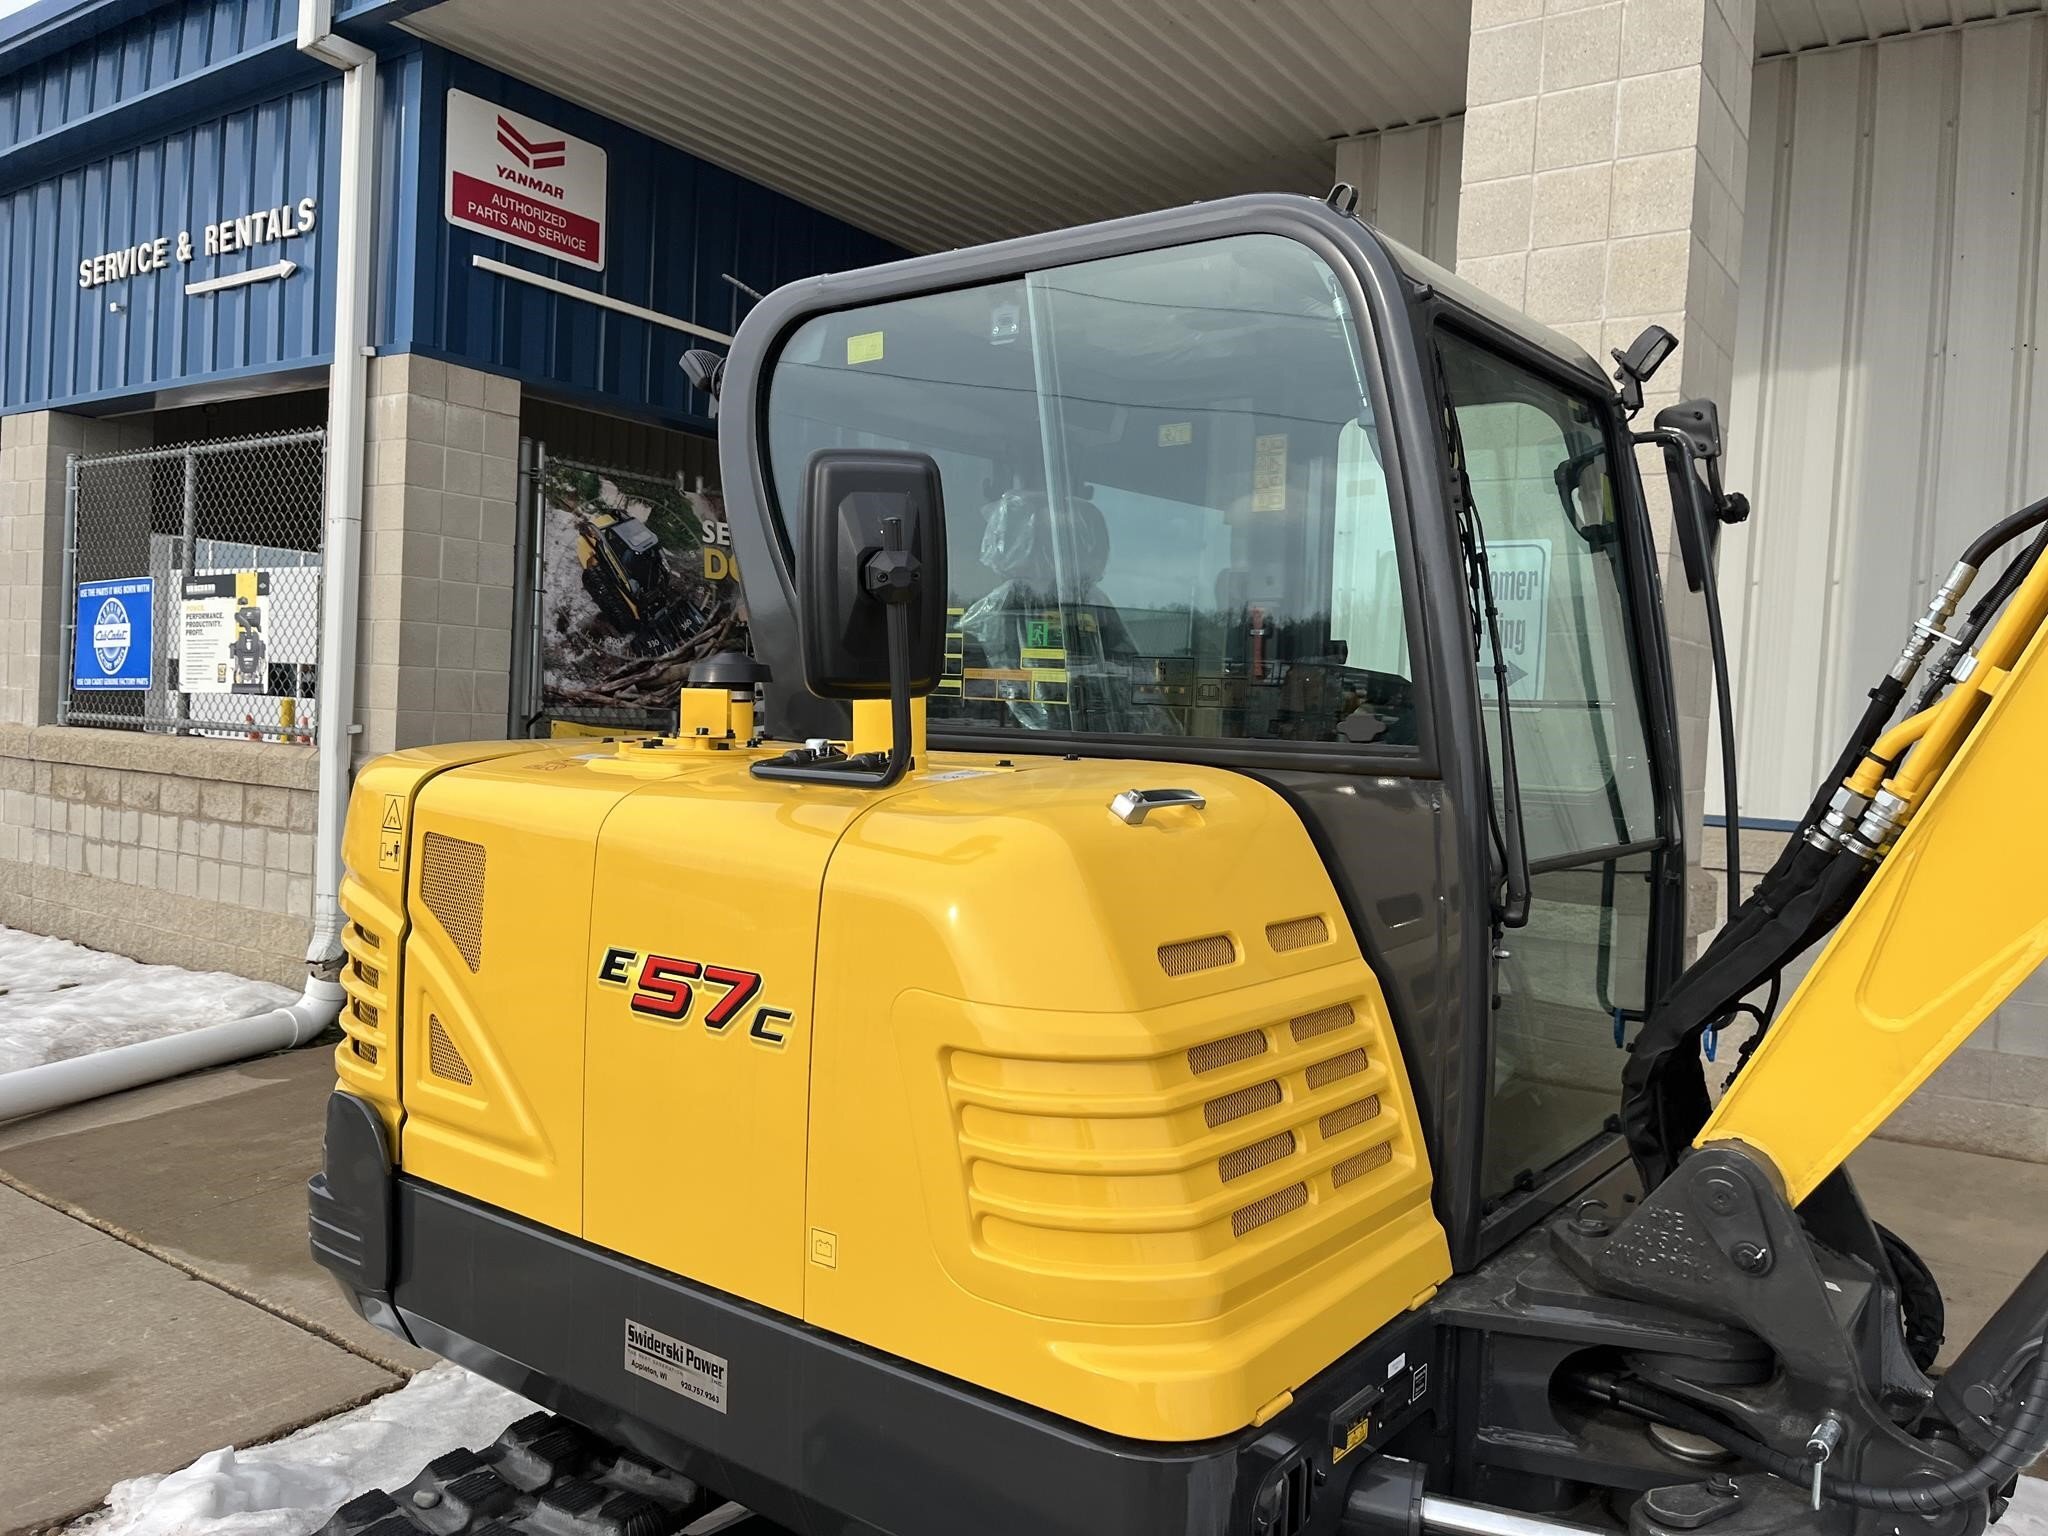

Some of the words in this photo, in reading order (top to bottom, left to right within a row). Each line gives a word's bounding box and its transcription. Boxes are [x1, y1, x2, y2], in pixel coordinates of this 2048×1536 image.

[496, 164, 565, 200] YANMAR
[468, 202, 508, 226] PARTS
[511, 216, 536, 234] AND
[538, 226, 587, 252] SERVICE
[491, 193, 567, 229] AUTHORIZED
[79, 237, 169, 288] SERVICE
[176, 231, 192, 263] &
[204, 197, 317, 257] RENTALS
[1488, 570, 1539, 601] omer
[628, 1324, 684, 1364] Swiderski
[686, 1348, 725, 1380] Power
[631, 1360, 659, 1378] Appleton,
[660, 1371, 668, 1381] WI
[681, 1381, 719, 1403] 920.757.9363
